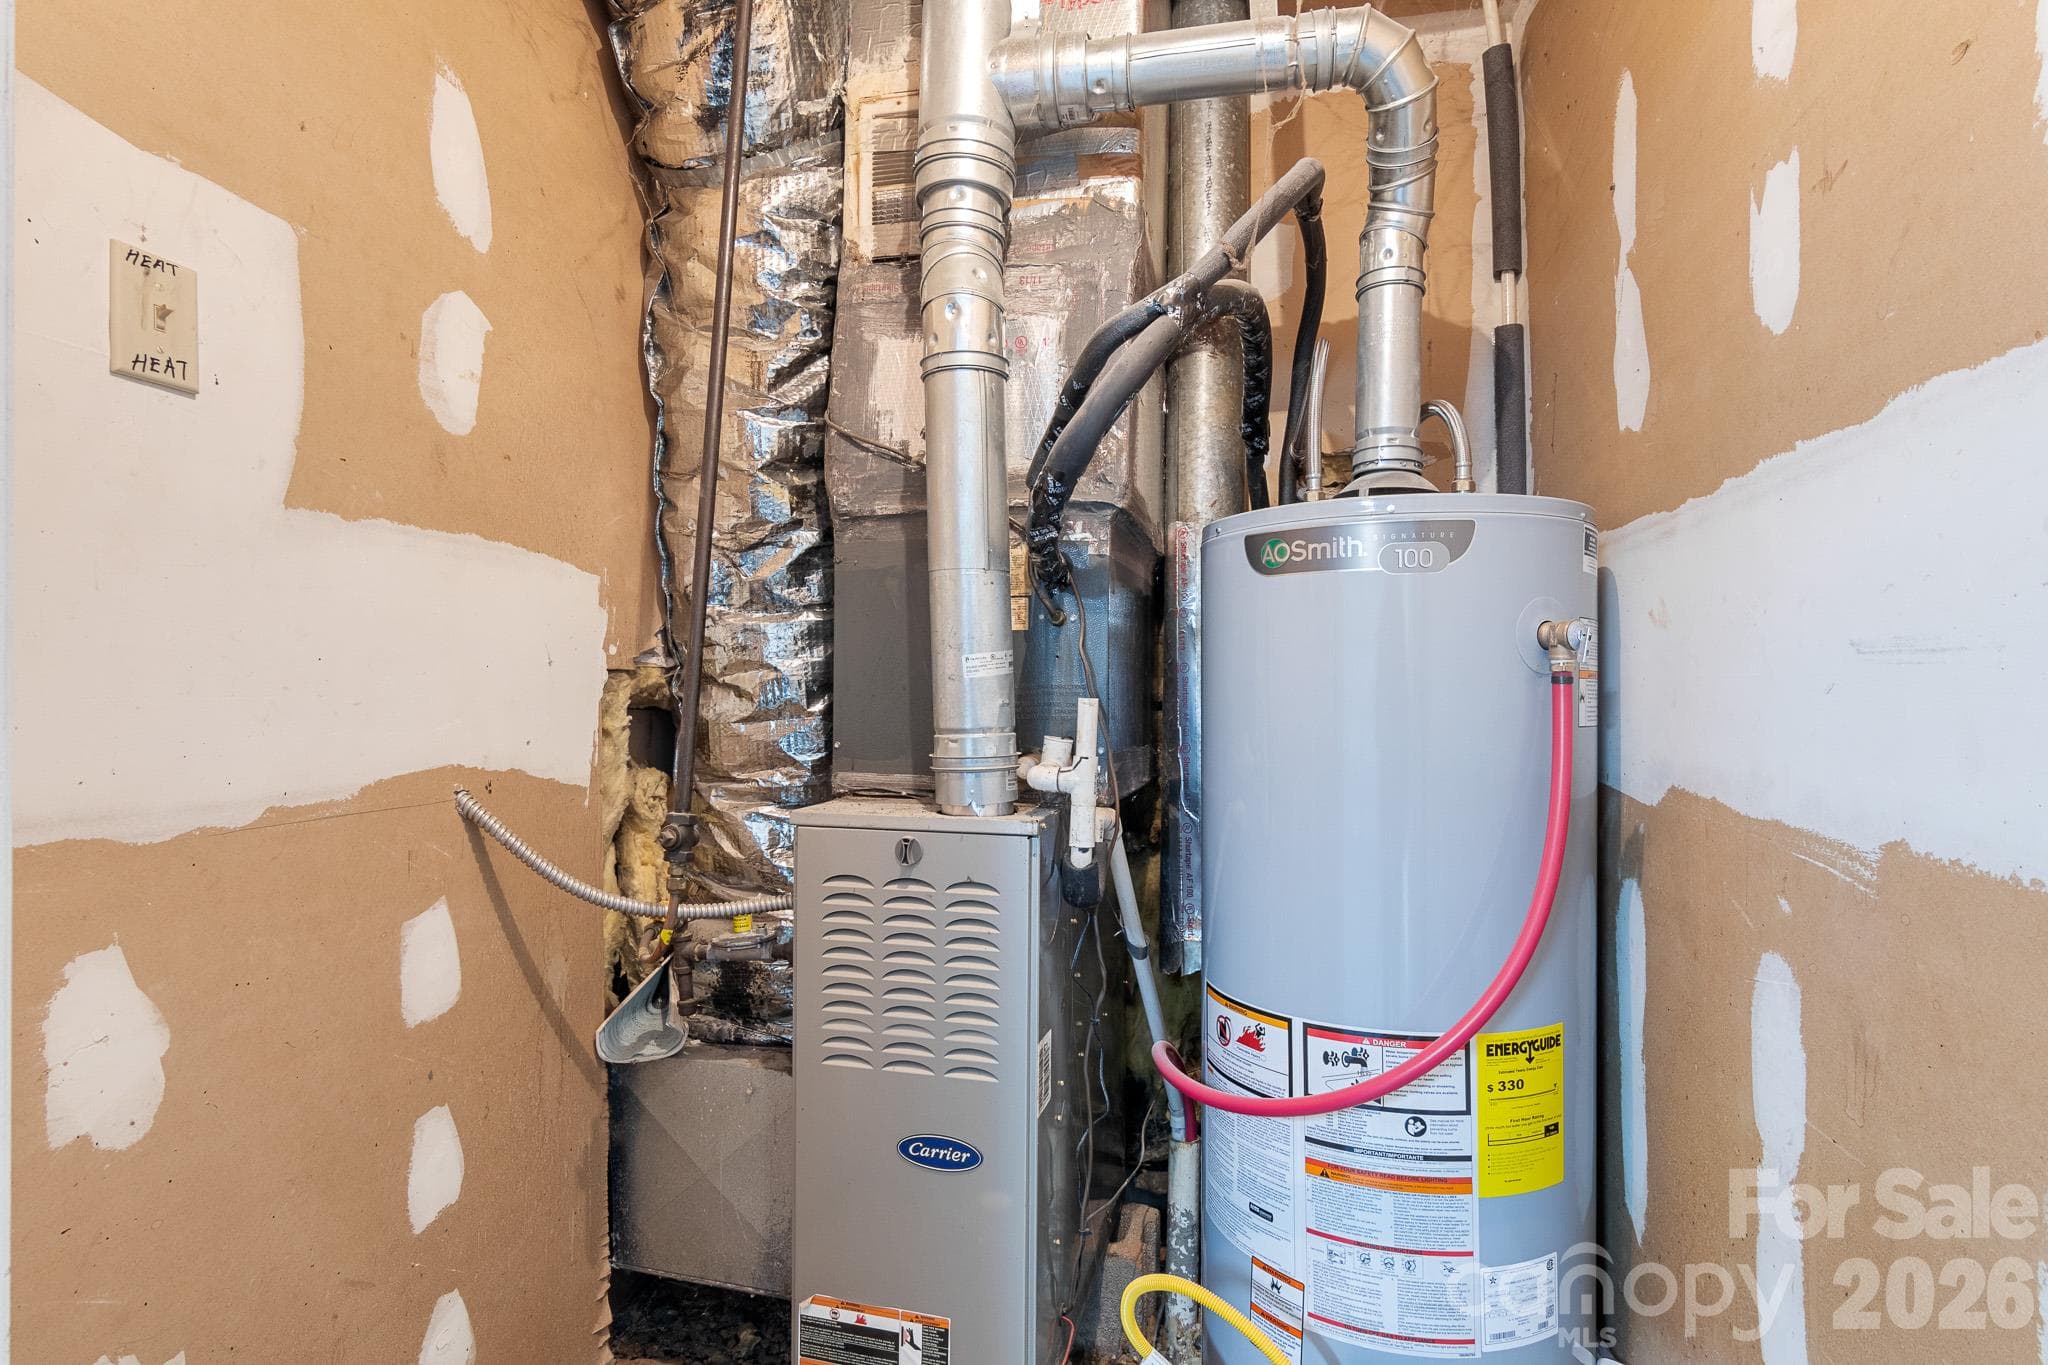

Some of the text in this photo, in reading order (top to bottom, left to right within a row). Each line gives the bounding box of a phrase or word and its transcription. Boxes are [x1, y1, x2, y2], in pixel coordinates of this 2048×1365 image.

[126, 249, 179, 276] HEAT
[132, 354, 187, 380] HEAT
[1373, 531, 1455, 540] SIGNATURE
[1395, 548, 1432, 568] 100
[1184, 836, 1194, 898] Shurtape AF 100
[1372, 1039, 1407, 1048] DANGER
[1486, 1034, 1561, 1061] ENERGYGUIDE
[1498, 1079, 1524, 1092] 330
[908, 1142, 971, 1163] Carrier
[1357, 1168, 1379, 1177] SAFETY
